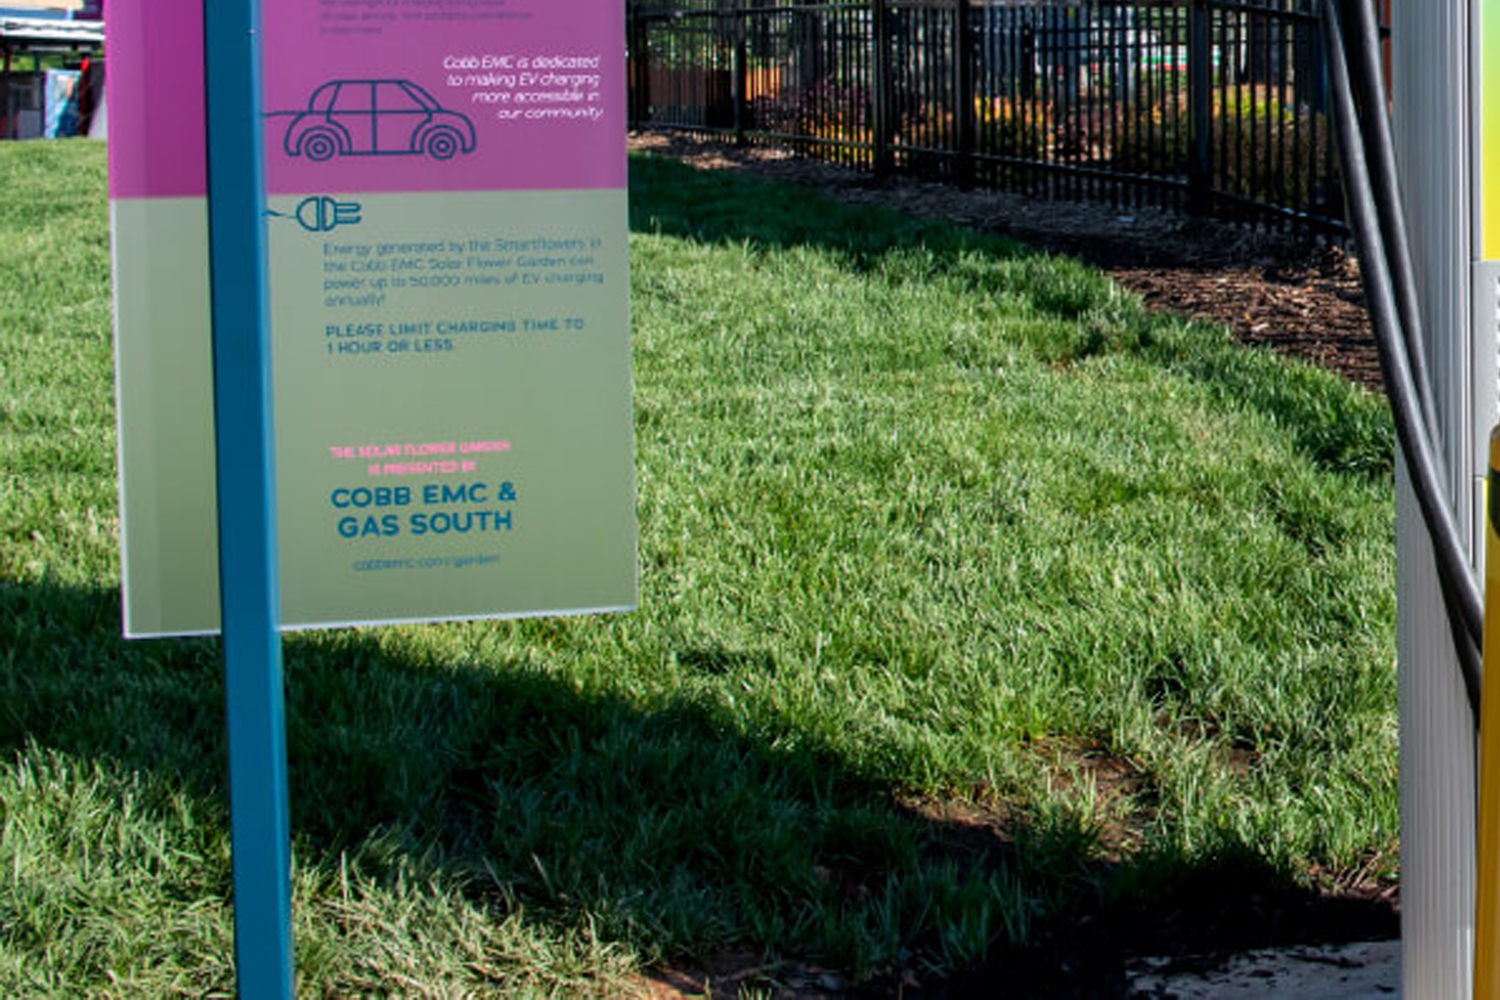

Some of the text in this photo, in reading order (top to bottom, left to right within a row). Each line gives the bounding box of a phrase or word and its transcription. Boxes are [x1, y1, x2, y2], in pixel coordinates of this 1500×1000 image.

[443, 55, 600, 69] Cobb EMC is dedicated
[446, 73, 600, 88] to making EV charging
[471, 88, 600, 103] more accessible in
[498, 108, 523, 119] our
[323, 243, 372, 257] Energy
[376, 241, 446, 256] generated
[448, 240, 463, 254] by
[468, 239, 491, 252] the
[323, 260, 346, 272] the
[350, 259, 387, 272] Cobb
[390, 258, 425, 271] EMC
[427, 257, 462, 270] Solar
[466, 256, 511, 269] Flower
[517, 255, 566, 268] Garden
[323, 279, 362, 292] power
[368, 278, 388, 290] up
[390, 276, 406, 288] to
[463, 273, 501, 286] miles
[504, 272, 519, 284] of
[521, 272, 540, 285] EV
[543, 272, 604, 287] charging
[325, 318, 585, 338] PLEASE LIMIT CHARGING TIME TO
[326, 341, 334, 355] 1
[337, 340, 382, 355] HOUR
[386, 339, 410, 353] OR
[330, 445, 355, 459] THE
[358, 444, 401, 459] SOLAR
[404, 441, 455, 456] FLOWER
[383, 460, 459, 475] PRESENTED
[330, 480, 517, 508] COBB EMC &
[336, 507, 513, 539] GAS SOUTH
